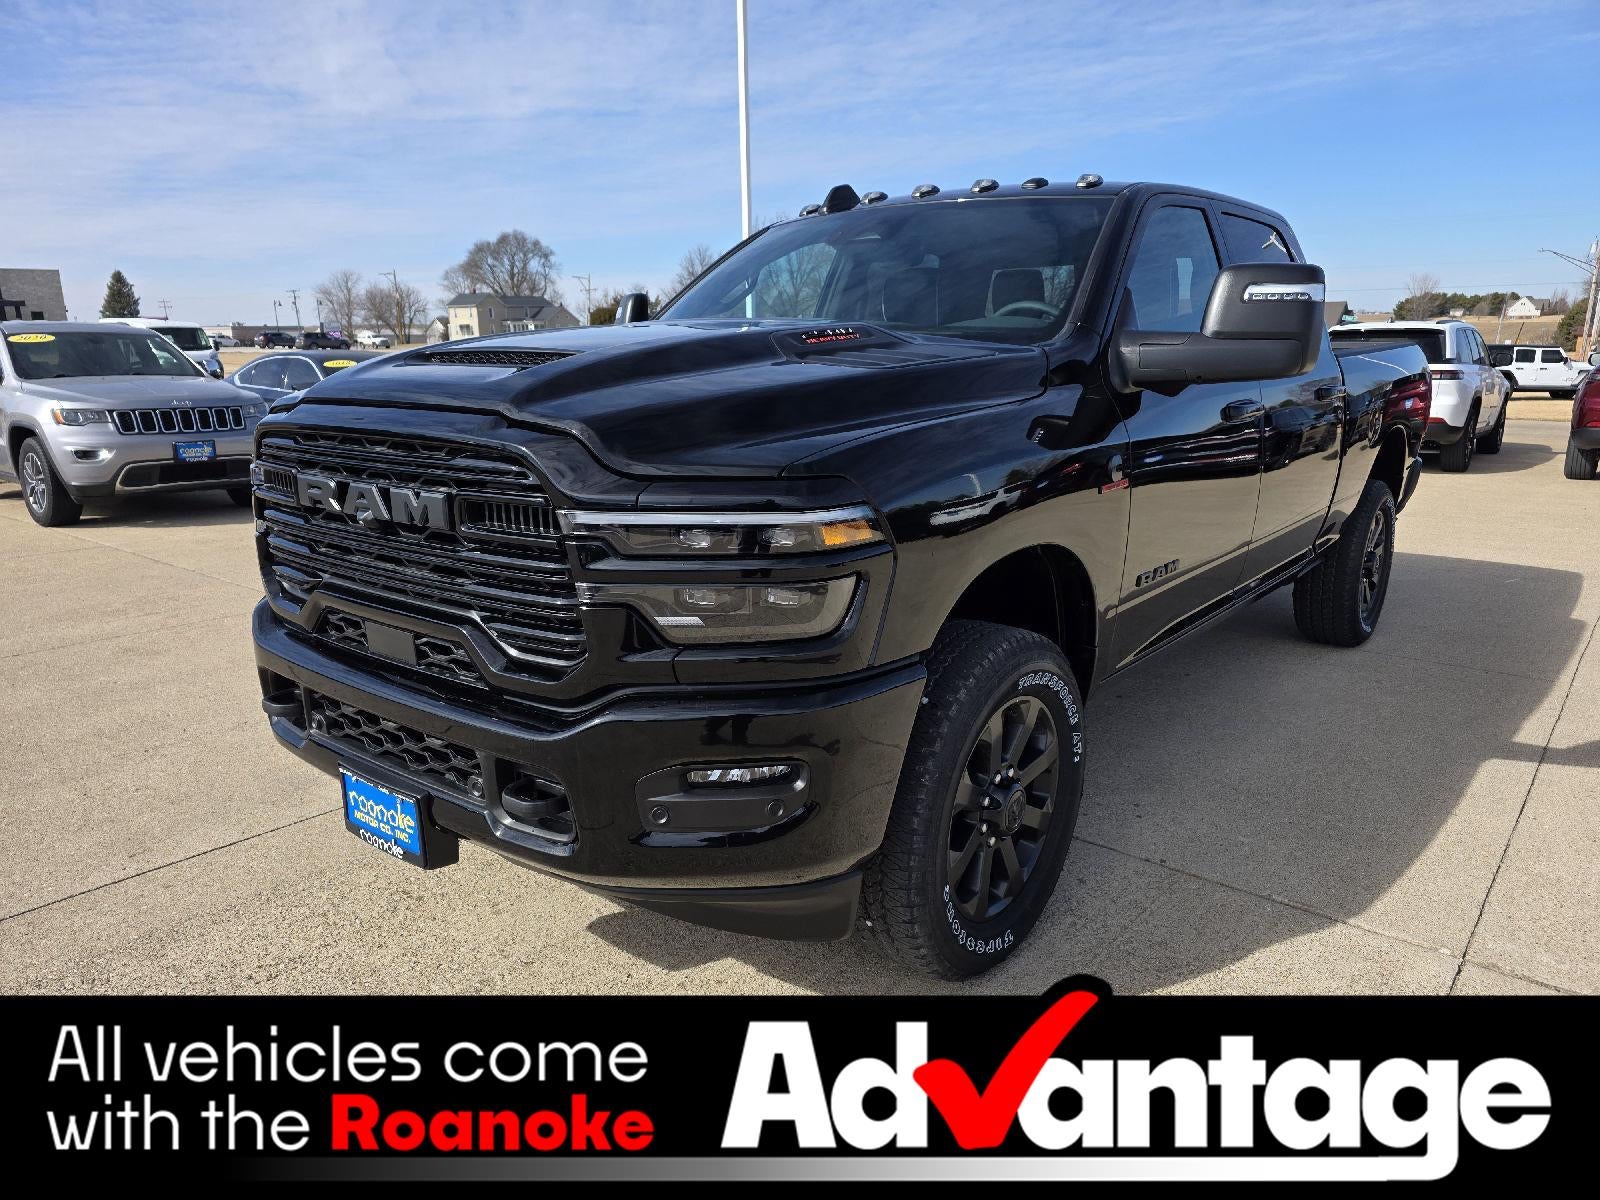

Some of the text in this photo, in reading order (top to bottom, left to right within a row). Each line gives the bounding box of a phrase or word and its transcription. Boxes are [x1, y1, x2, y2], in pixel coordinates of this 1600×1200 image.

[297, 473, 450, 531] RAM
[1135, 559, 1180, 588] RAM
[348, 790, 415, 835] roanoke
[353, 809, 379, 829] MOTOR
[379, 823, 394, 836] CO.
[359, 828, 404, 859] roanoke
